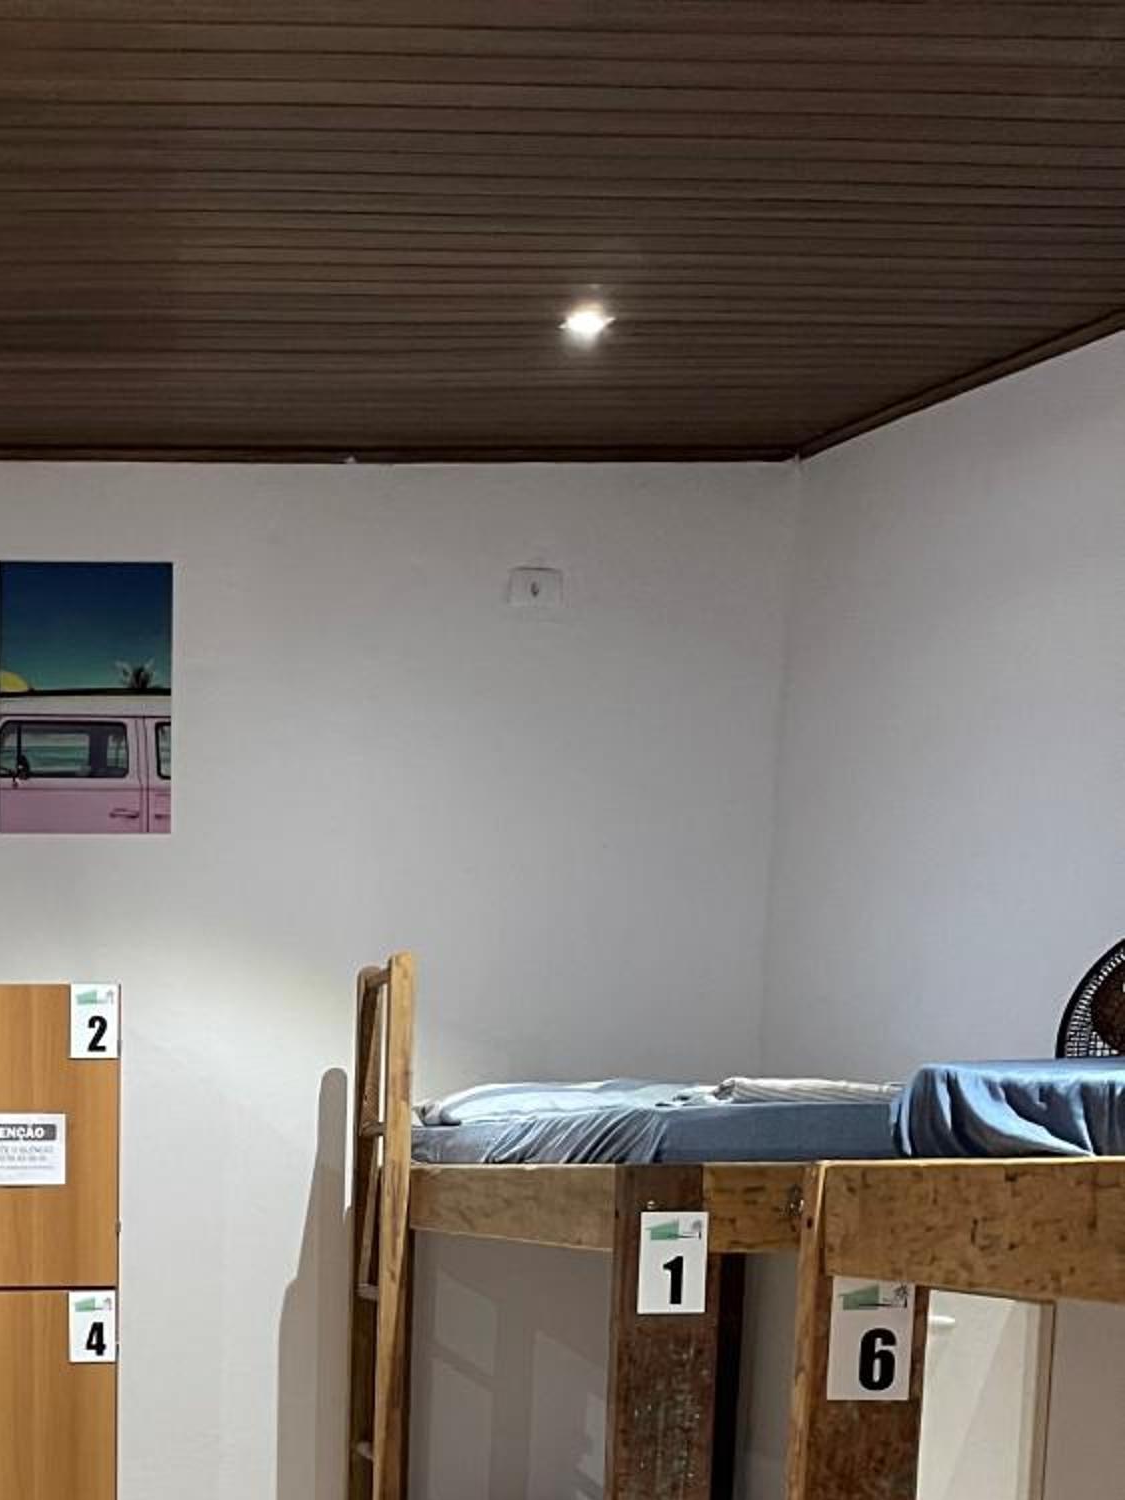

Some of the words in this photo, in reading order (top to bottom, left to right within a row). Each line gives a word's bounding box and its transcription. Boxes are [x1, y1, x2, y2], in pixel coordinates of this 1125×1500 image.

[87, 1015, 108, 1052] 2
[662, 1255, 684, 1305] 1
[85, 1321, 107, 1356] 4
[858, 1327, 898, 1391] 6
